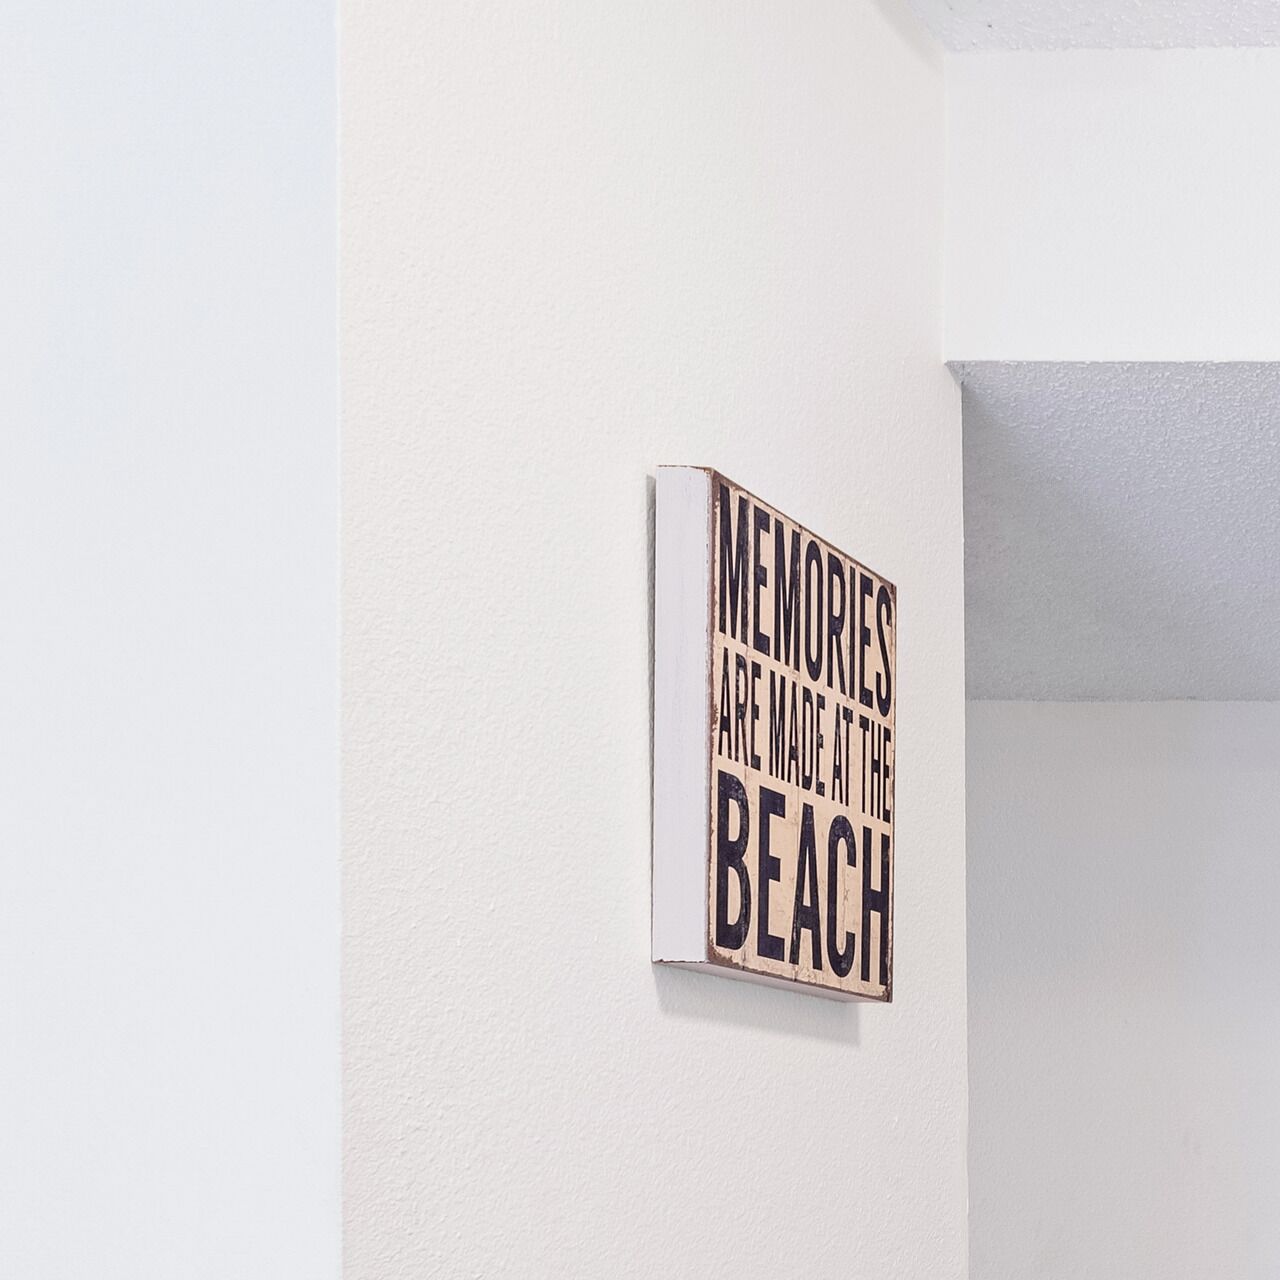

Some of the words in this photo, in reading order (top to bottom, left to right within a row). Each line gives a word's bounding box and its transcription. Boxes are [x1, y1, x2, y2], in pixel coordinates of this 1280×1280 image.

[718, 485, 893, 717] MEMORIES
[718, 647, 761, 772] ARE
[769, 670, 825, 797] MADE
[833, 702, 854, 807] AT
[859, 714, 891, 823] THE
[715, 769, 890, 986] BEACH
